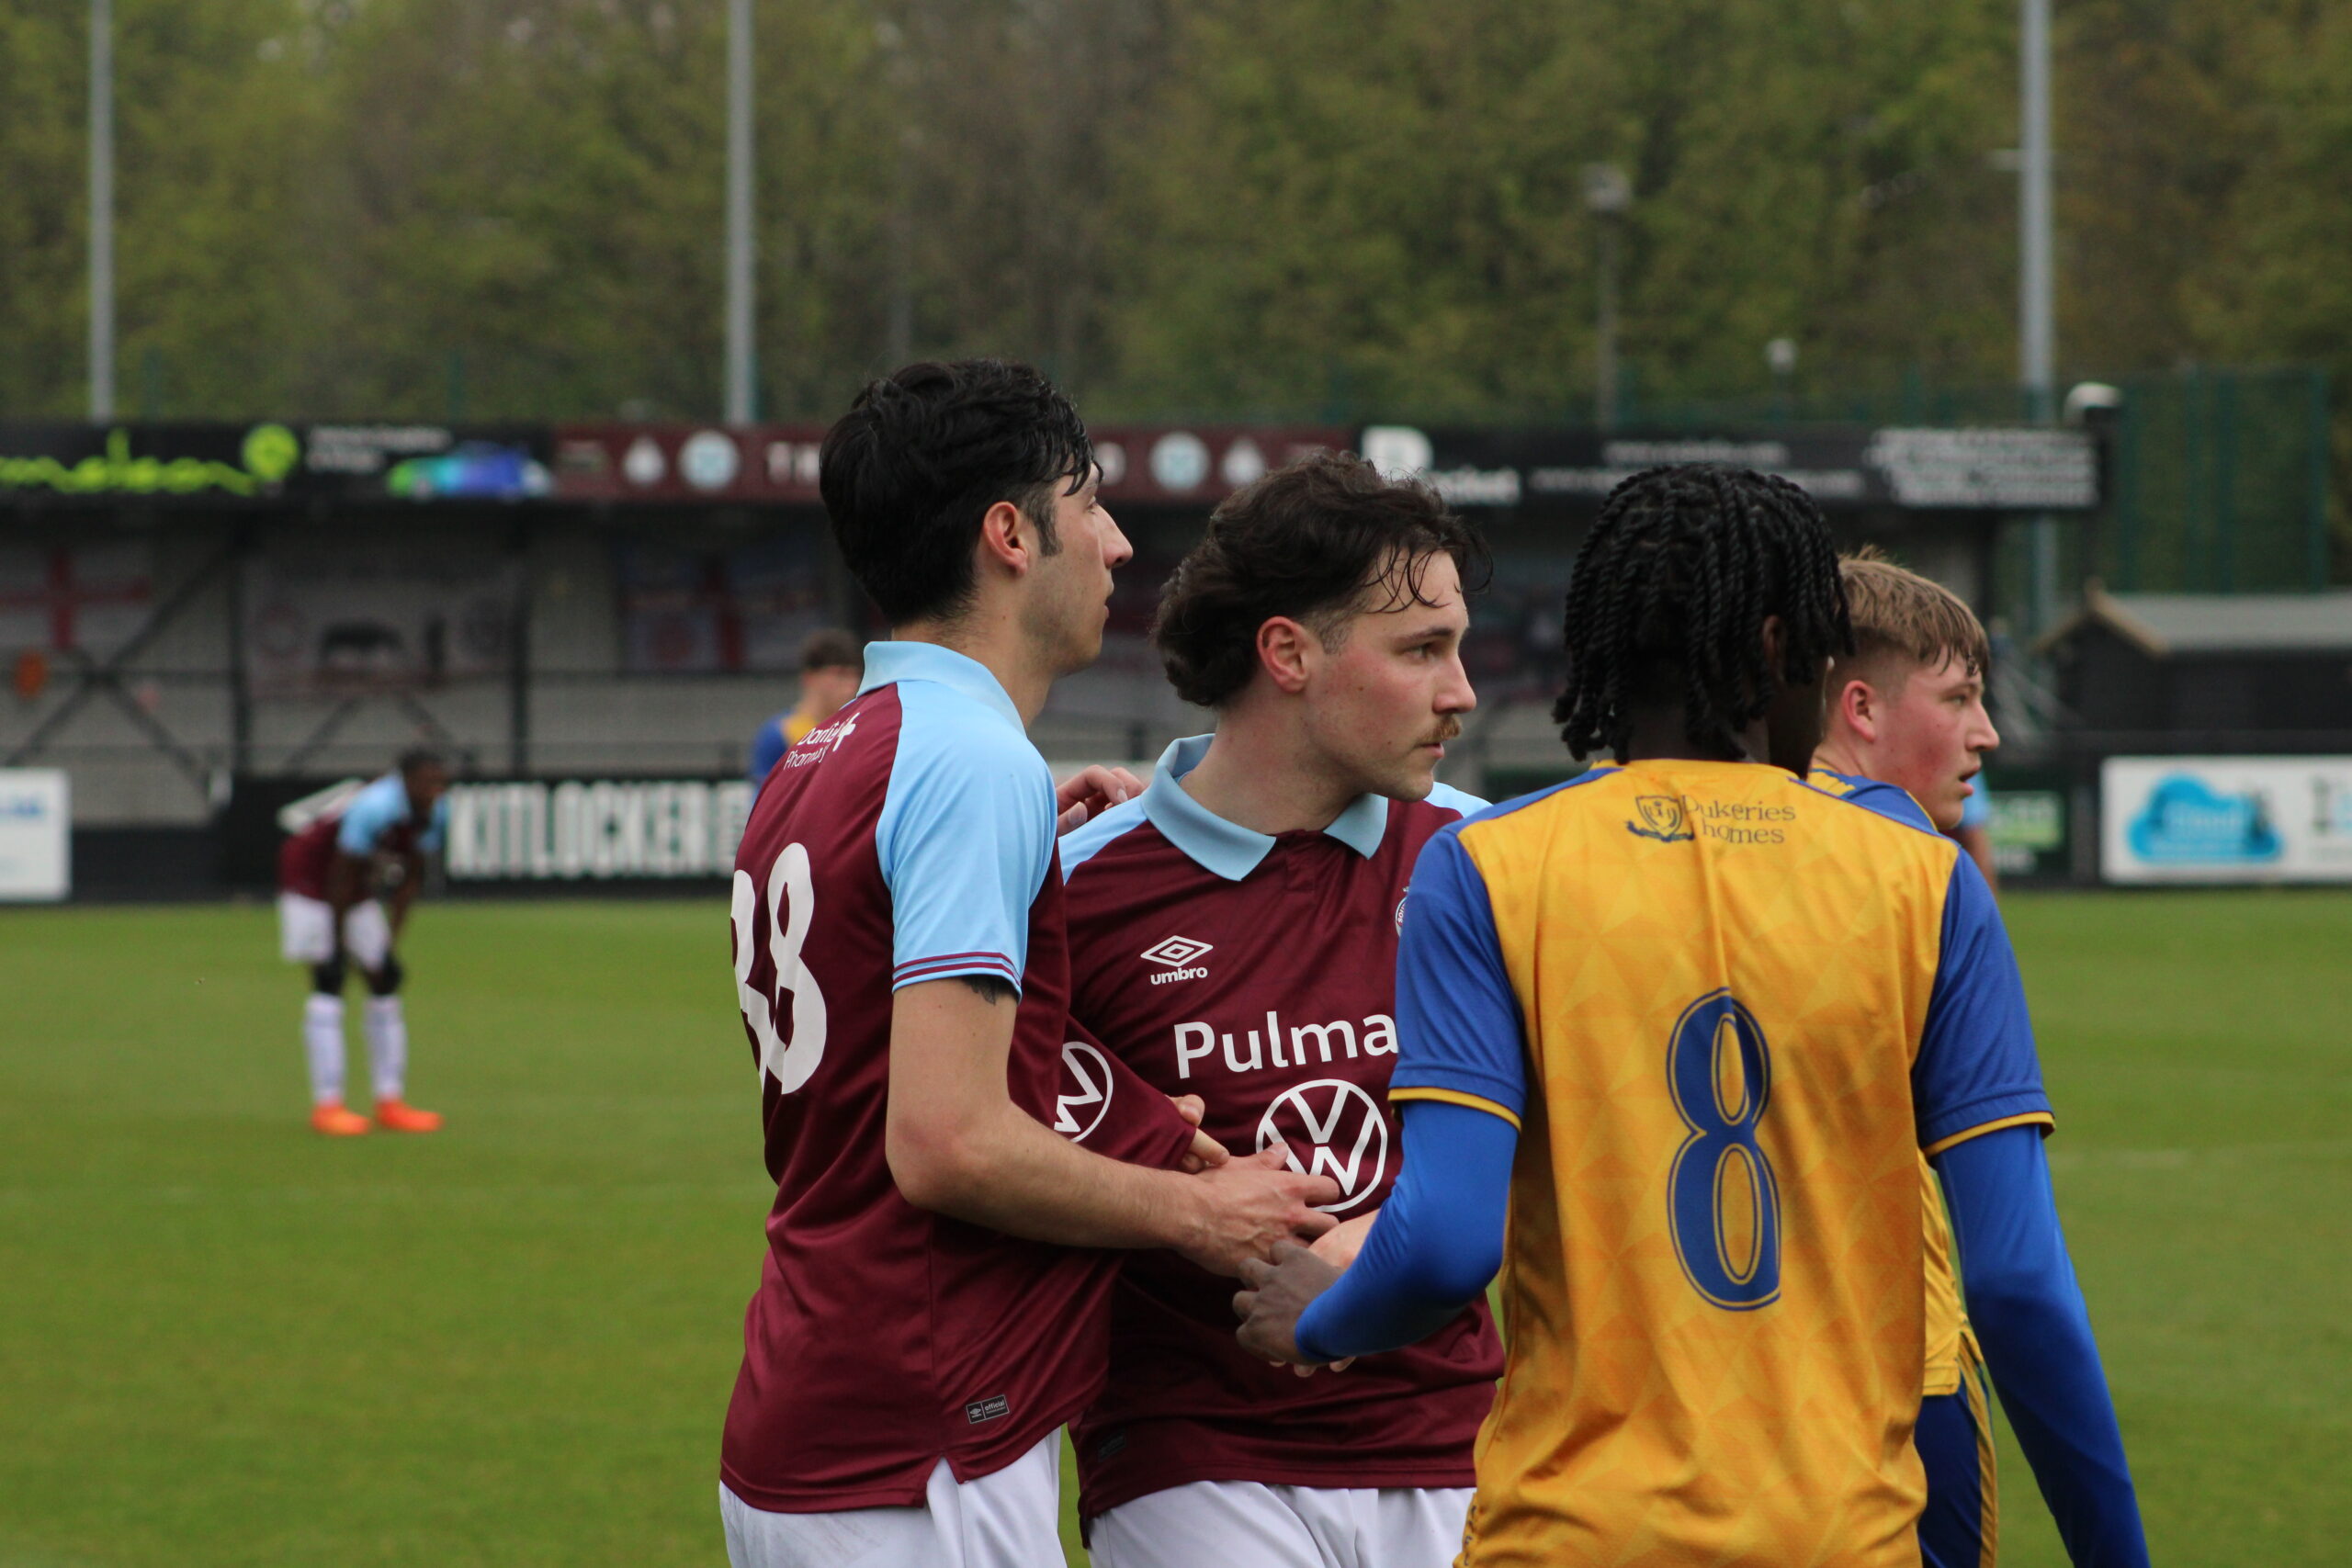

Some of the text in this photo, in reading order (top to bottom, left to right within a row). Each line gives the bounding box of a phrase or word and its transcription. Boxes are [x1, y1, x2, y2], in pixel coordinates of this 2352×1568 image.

[1680, 795, 1797, 821] Dukeries
[1702, 818, 1786, 844] homes
[1150, 965, 1208, 986] umbro
[1173, 1010, 1399, 1079] Pulma
[1666, 987, 1781, 1312] 8
[984, 1399, 1006, 1411] official
